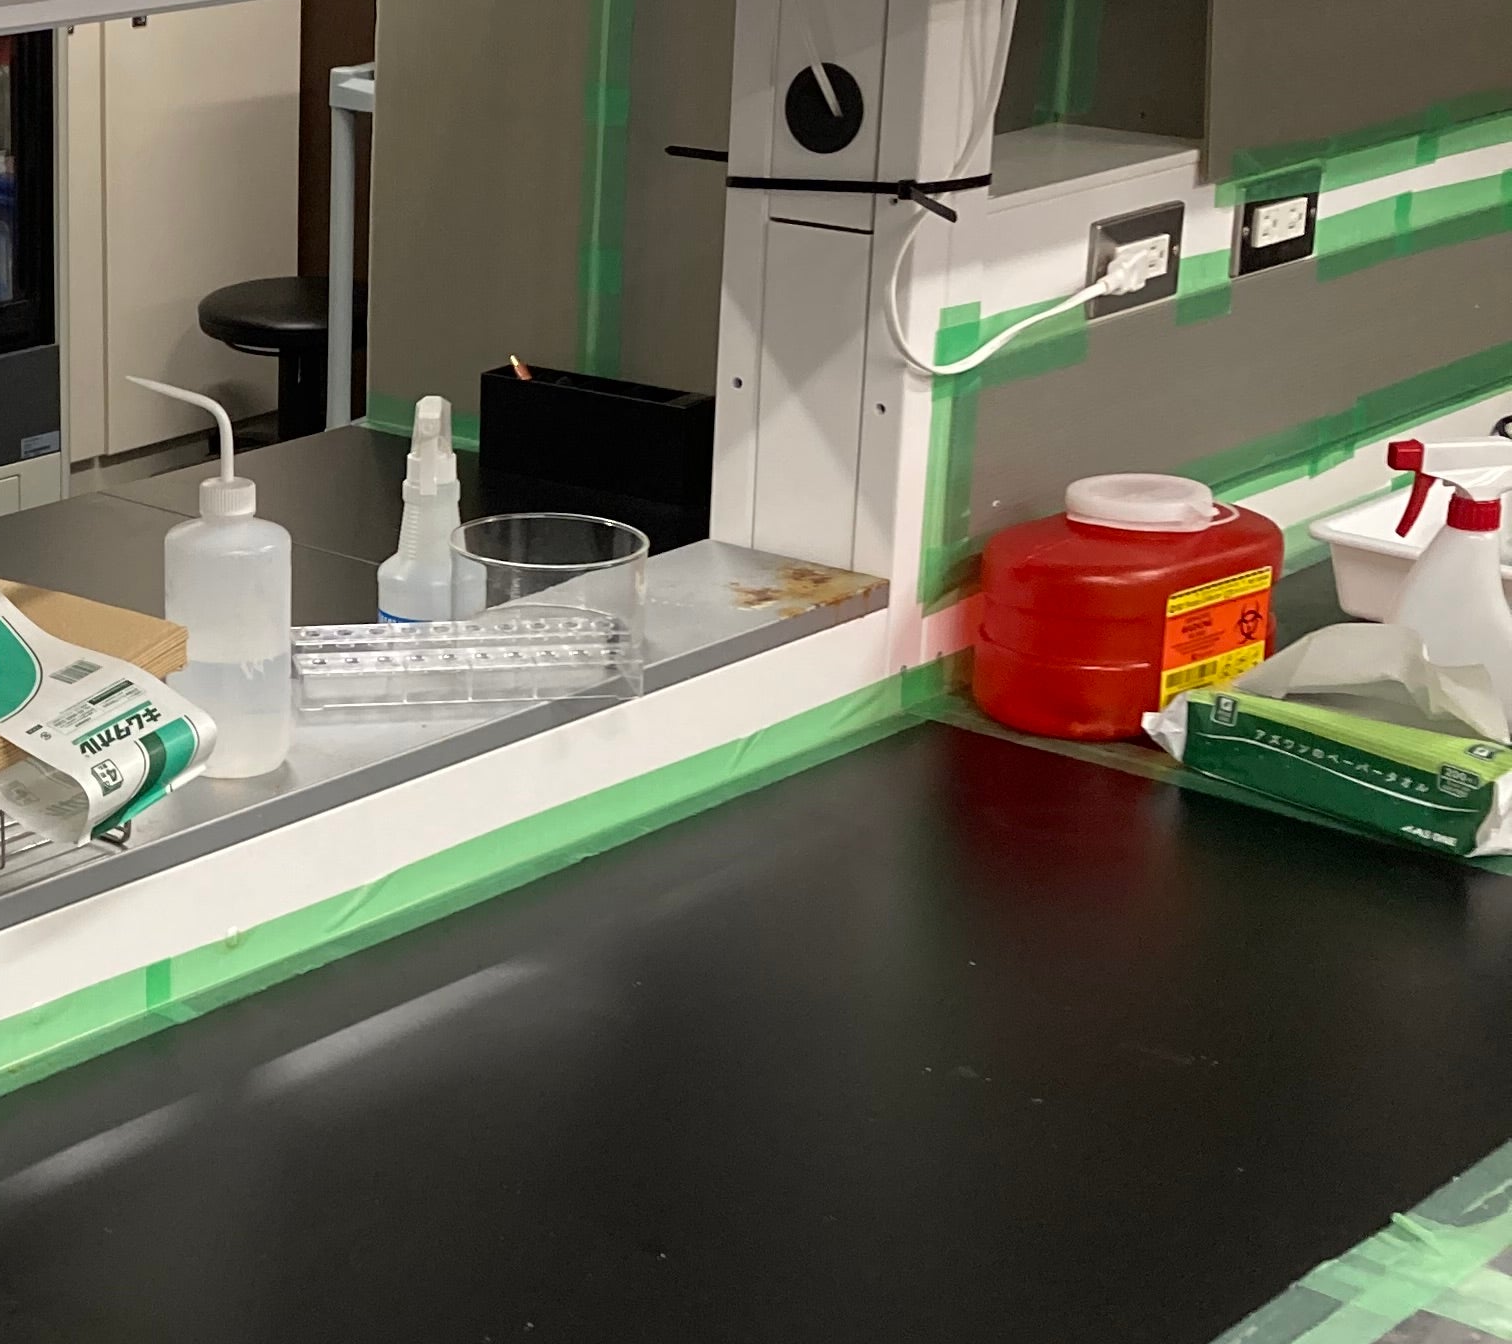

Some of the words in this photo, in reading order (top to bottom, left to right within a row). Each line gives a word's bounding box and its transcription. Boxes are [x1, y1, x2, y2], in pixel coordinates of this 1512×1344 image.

[78, 707, 163, 757] キムタオル
